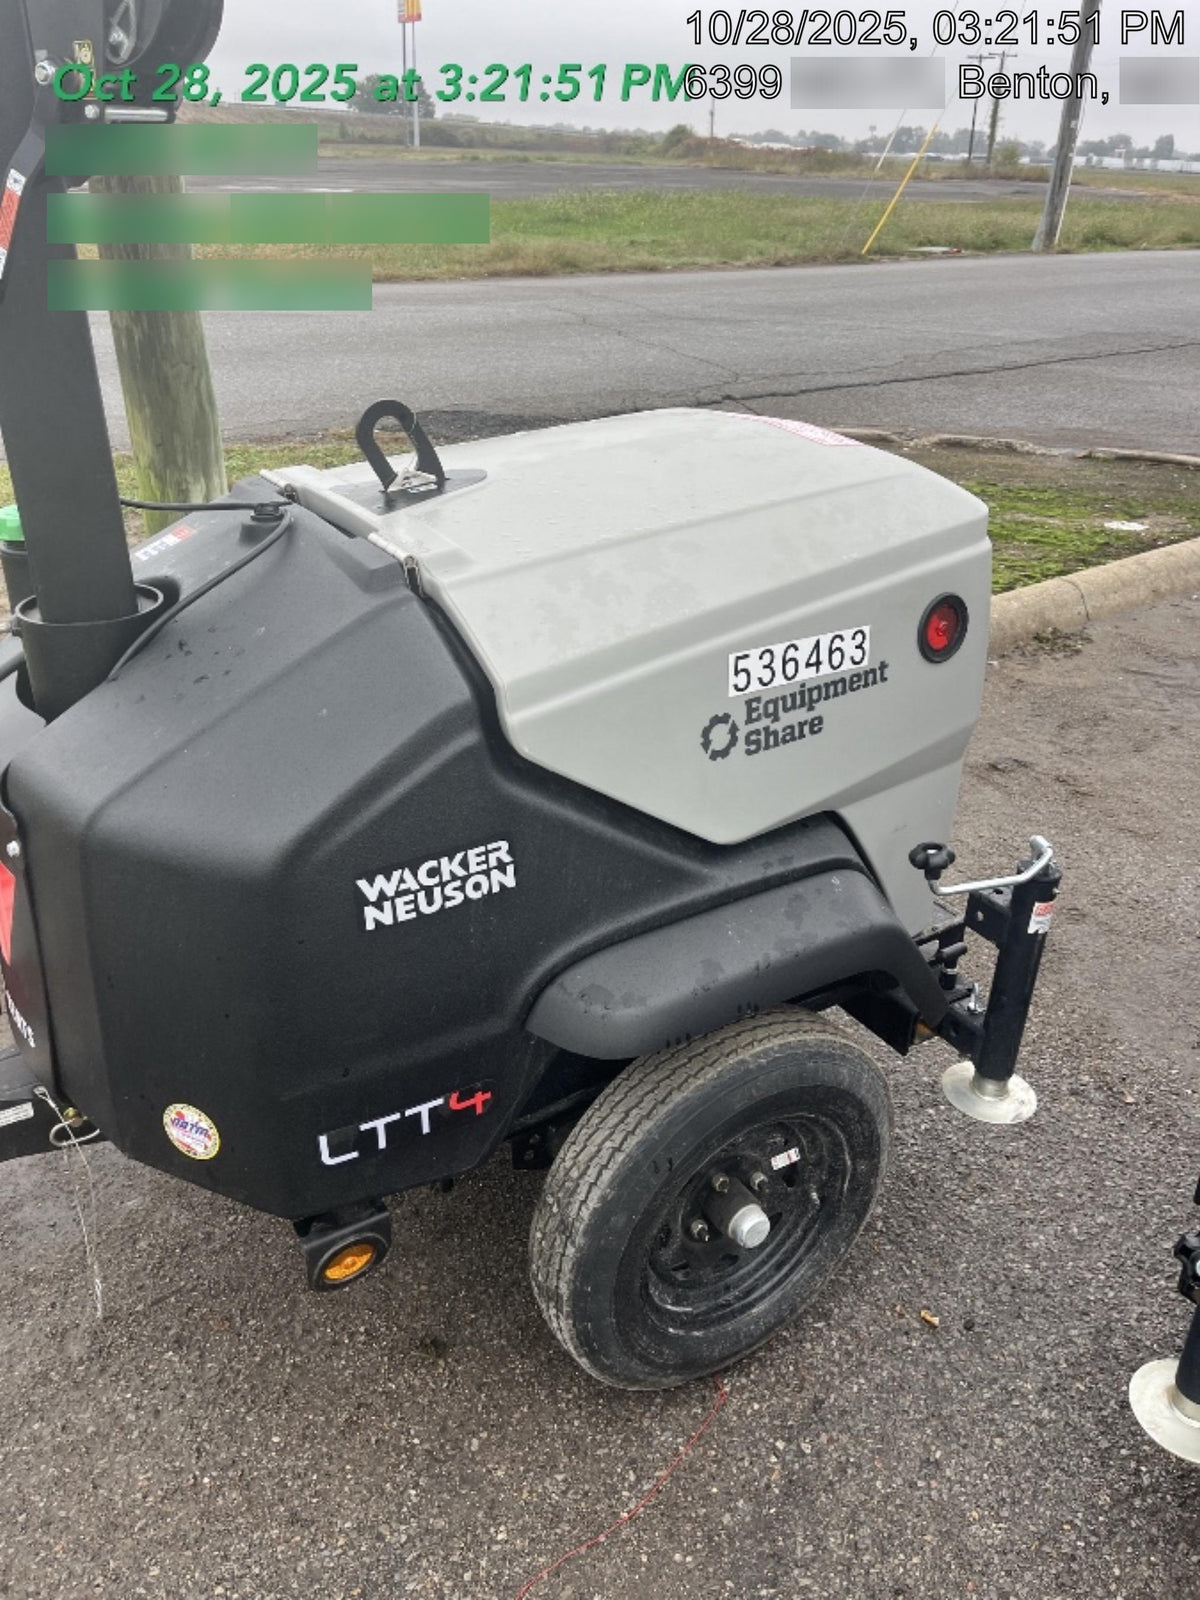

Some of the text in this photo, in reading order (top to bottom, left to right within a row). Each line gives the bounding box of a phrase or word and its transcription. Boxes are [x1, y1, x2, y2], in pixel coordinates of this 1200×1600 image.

[732, 628, 868, 692] 536463
[744, 660, 889, 725] Equipment
[744, 714, 824, 756] Share
[355, 840, 514, 902] WACKER
[363, 863, 517, 931] NEUSON
[318, 1091, 492, 1166] LTT4
